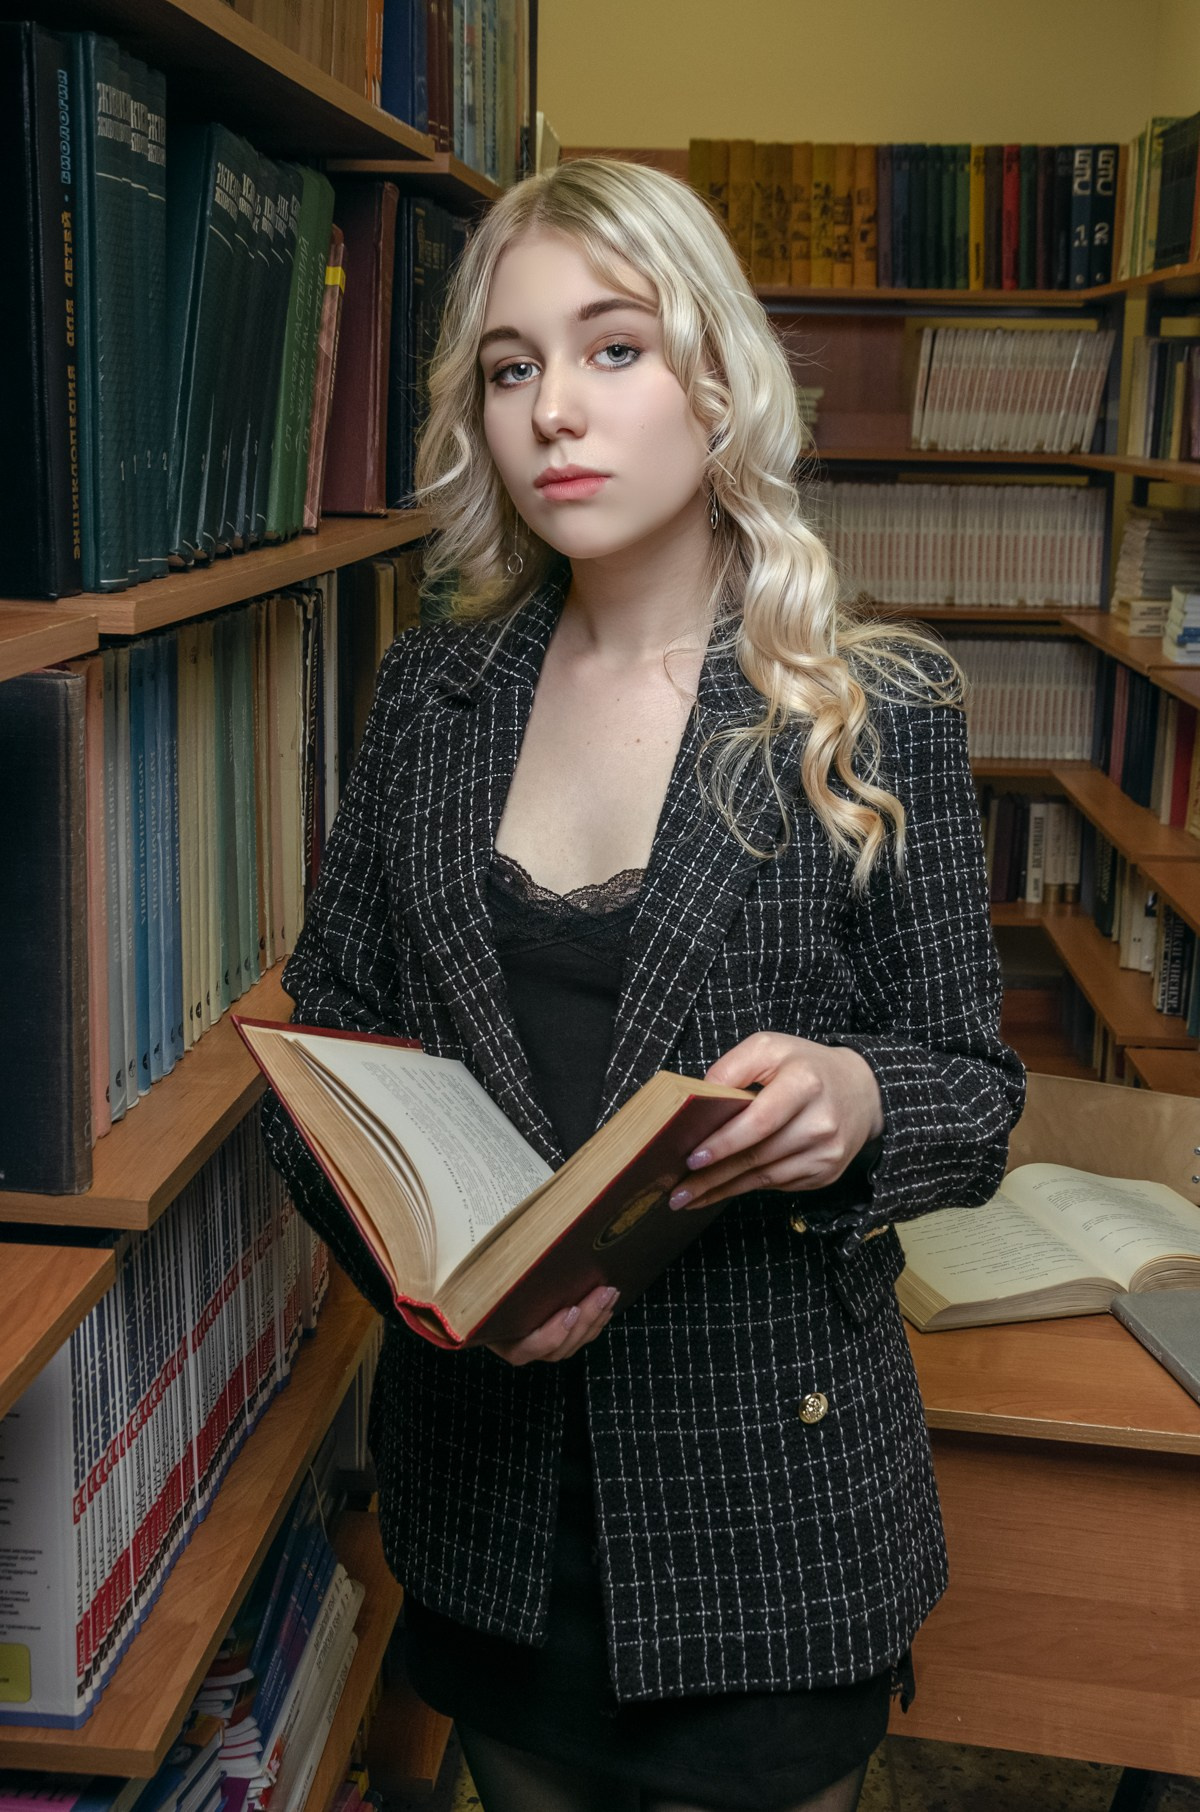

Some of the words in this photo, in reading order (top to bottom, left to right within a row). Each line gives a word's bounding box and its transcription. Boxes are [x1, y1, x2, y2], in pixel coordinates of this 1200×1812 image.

[57, 69, 71, 184] БИОЛОГИЯ
[61, 210, 73, 287] ДЕТЕЙ
[65, 298, 75, 347] ДЛЯ
[66, 364, 80, 560] ЭНЦИКЛОПЕДИЯ
[1168, 960, 1181, 1008] ЖИЗНЬ
